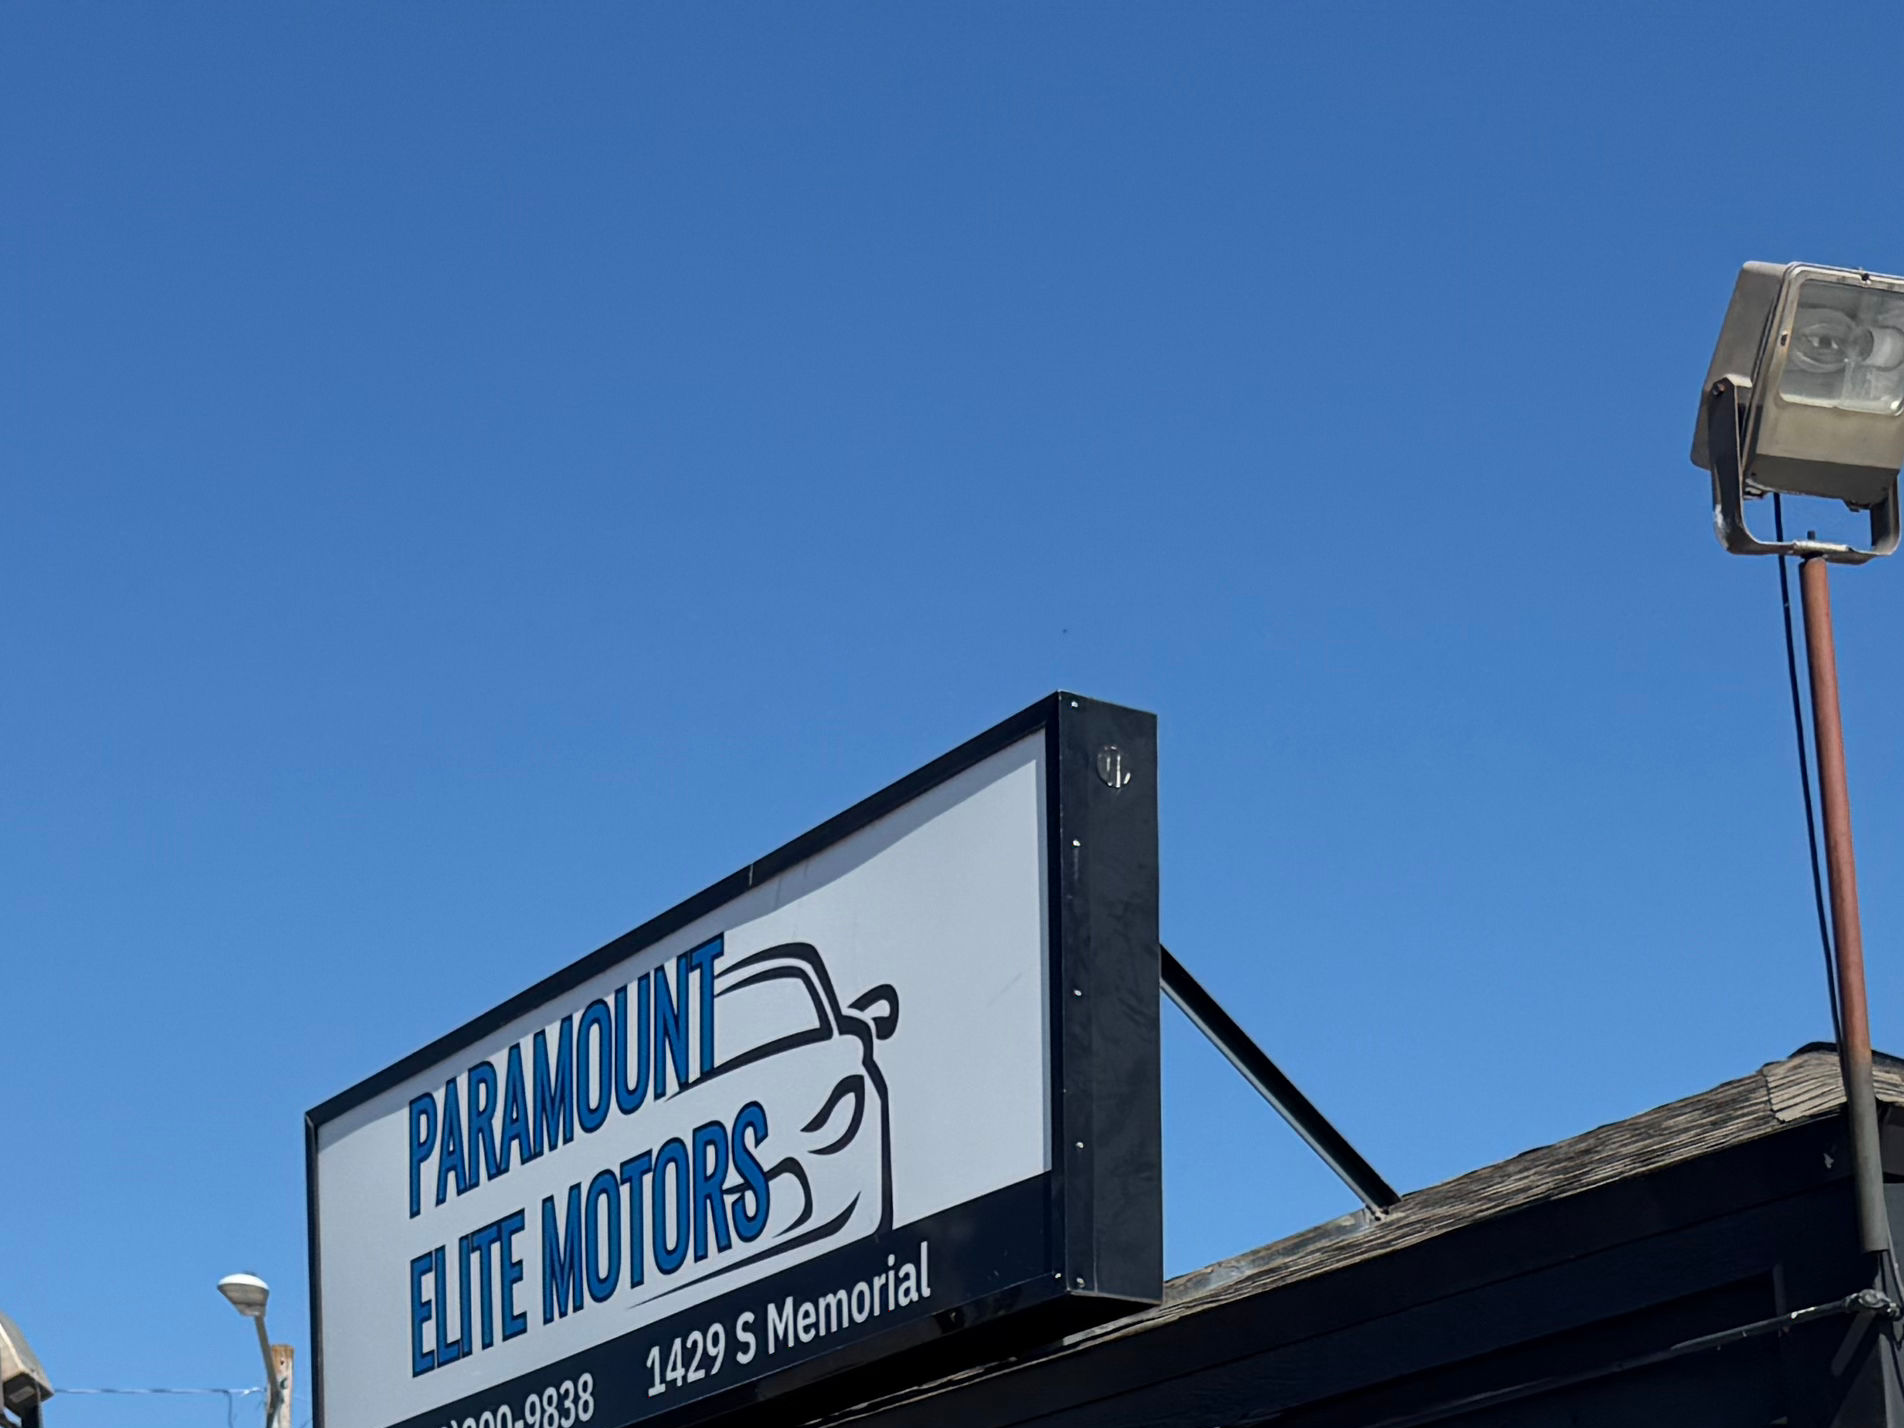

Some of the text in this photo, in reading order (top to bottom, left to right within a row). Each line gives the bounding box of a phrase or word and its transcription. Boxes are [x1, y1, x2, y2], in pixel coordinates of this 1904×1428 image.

[409, 931, 725, 1219] PARAMOUNT
[410, 1100, 771, 1378] ELITE MOTORS
[646, 1322, 726, 1397] 1429
[735, 1311, 757, 1364] S
[767, 1240, 931, 1355] Memorial
